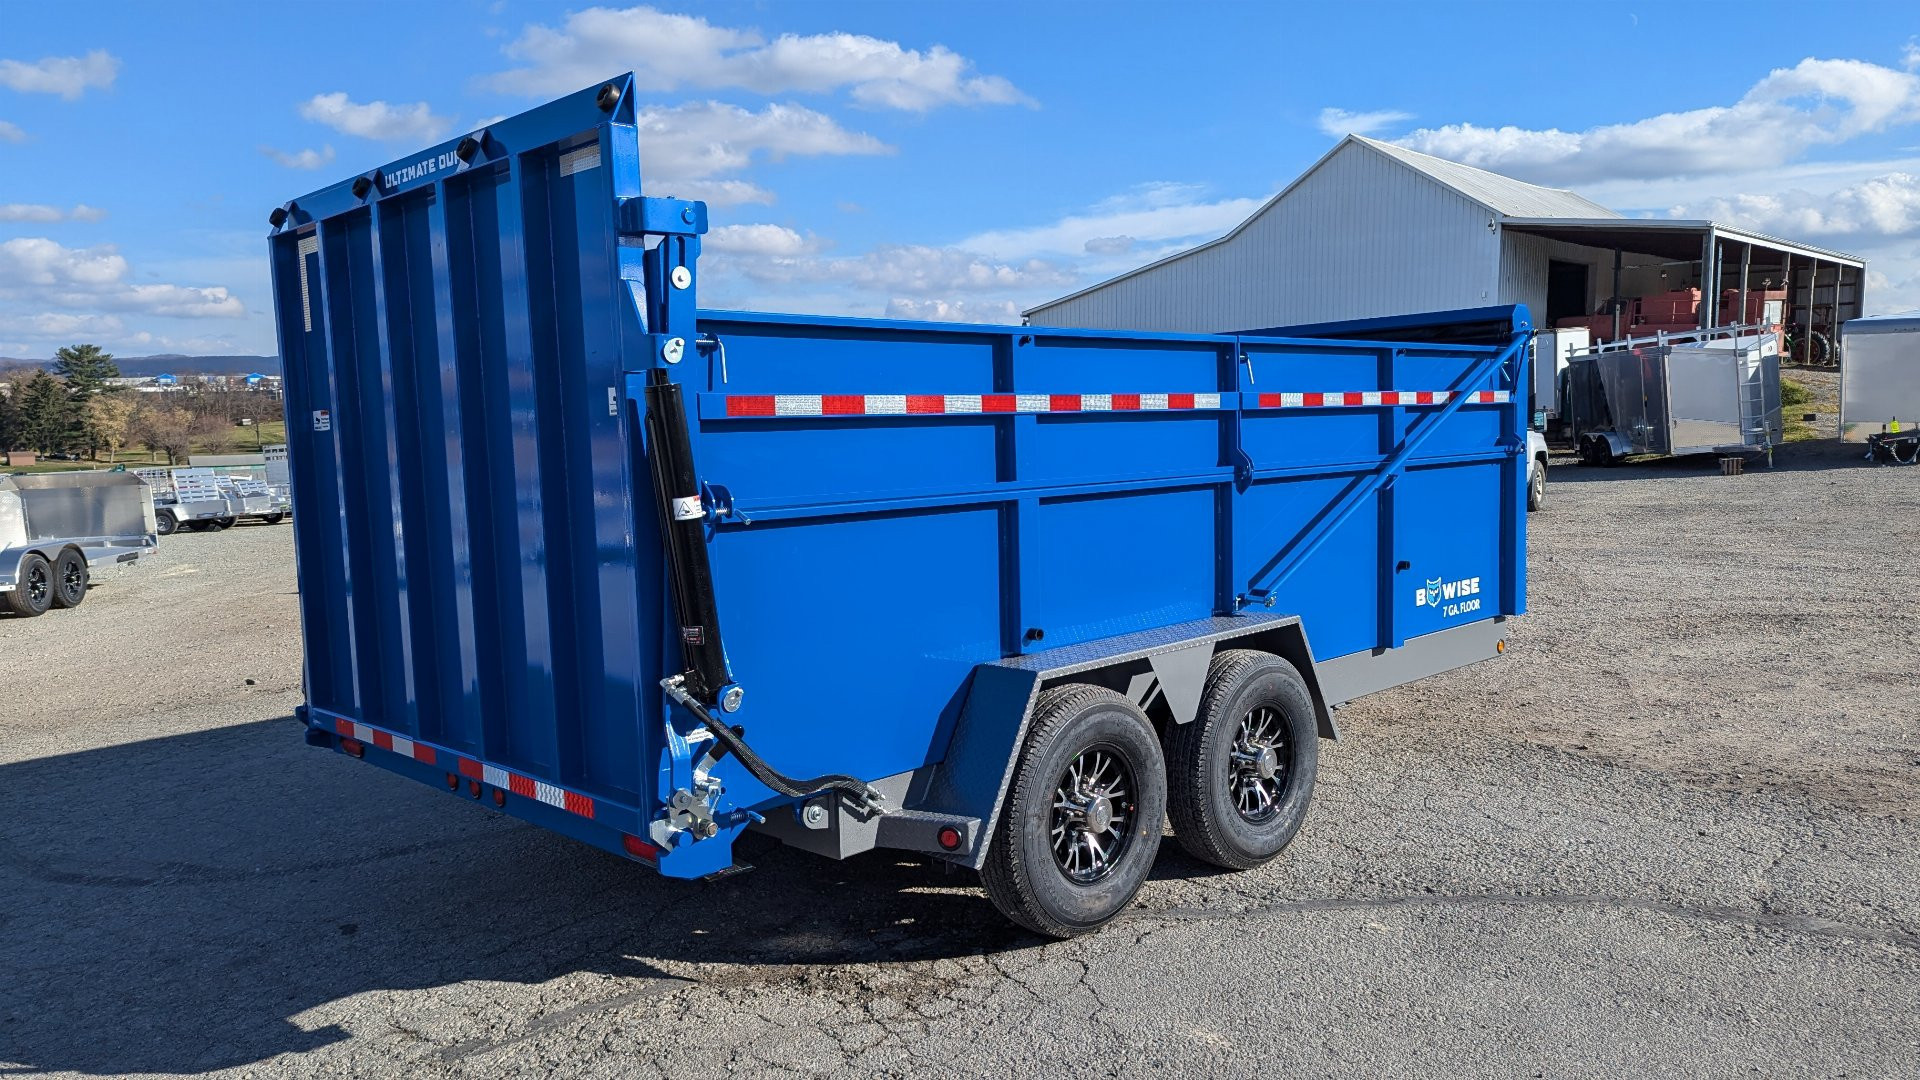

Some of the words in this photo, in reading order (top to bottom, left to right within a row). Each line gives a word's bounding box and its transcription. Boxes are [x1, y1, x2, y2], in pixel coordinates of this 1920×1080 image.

[385, 158, 436, 188] ULTIMATE
[1443, 606, 1448, 618] 7
[1448, 604, 1460, 616] GA.
[1460, 599, 1480, 613] FLOOR
